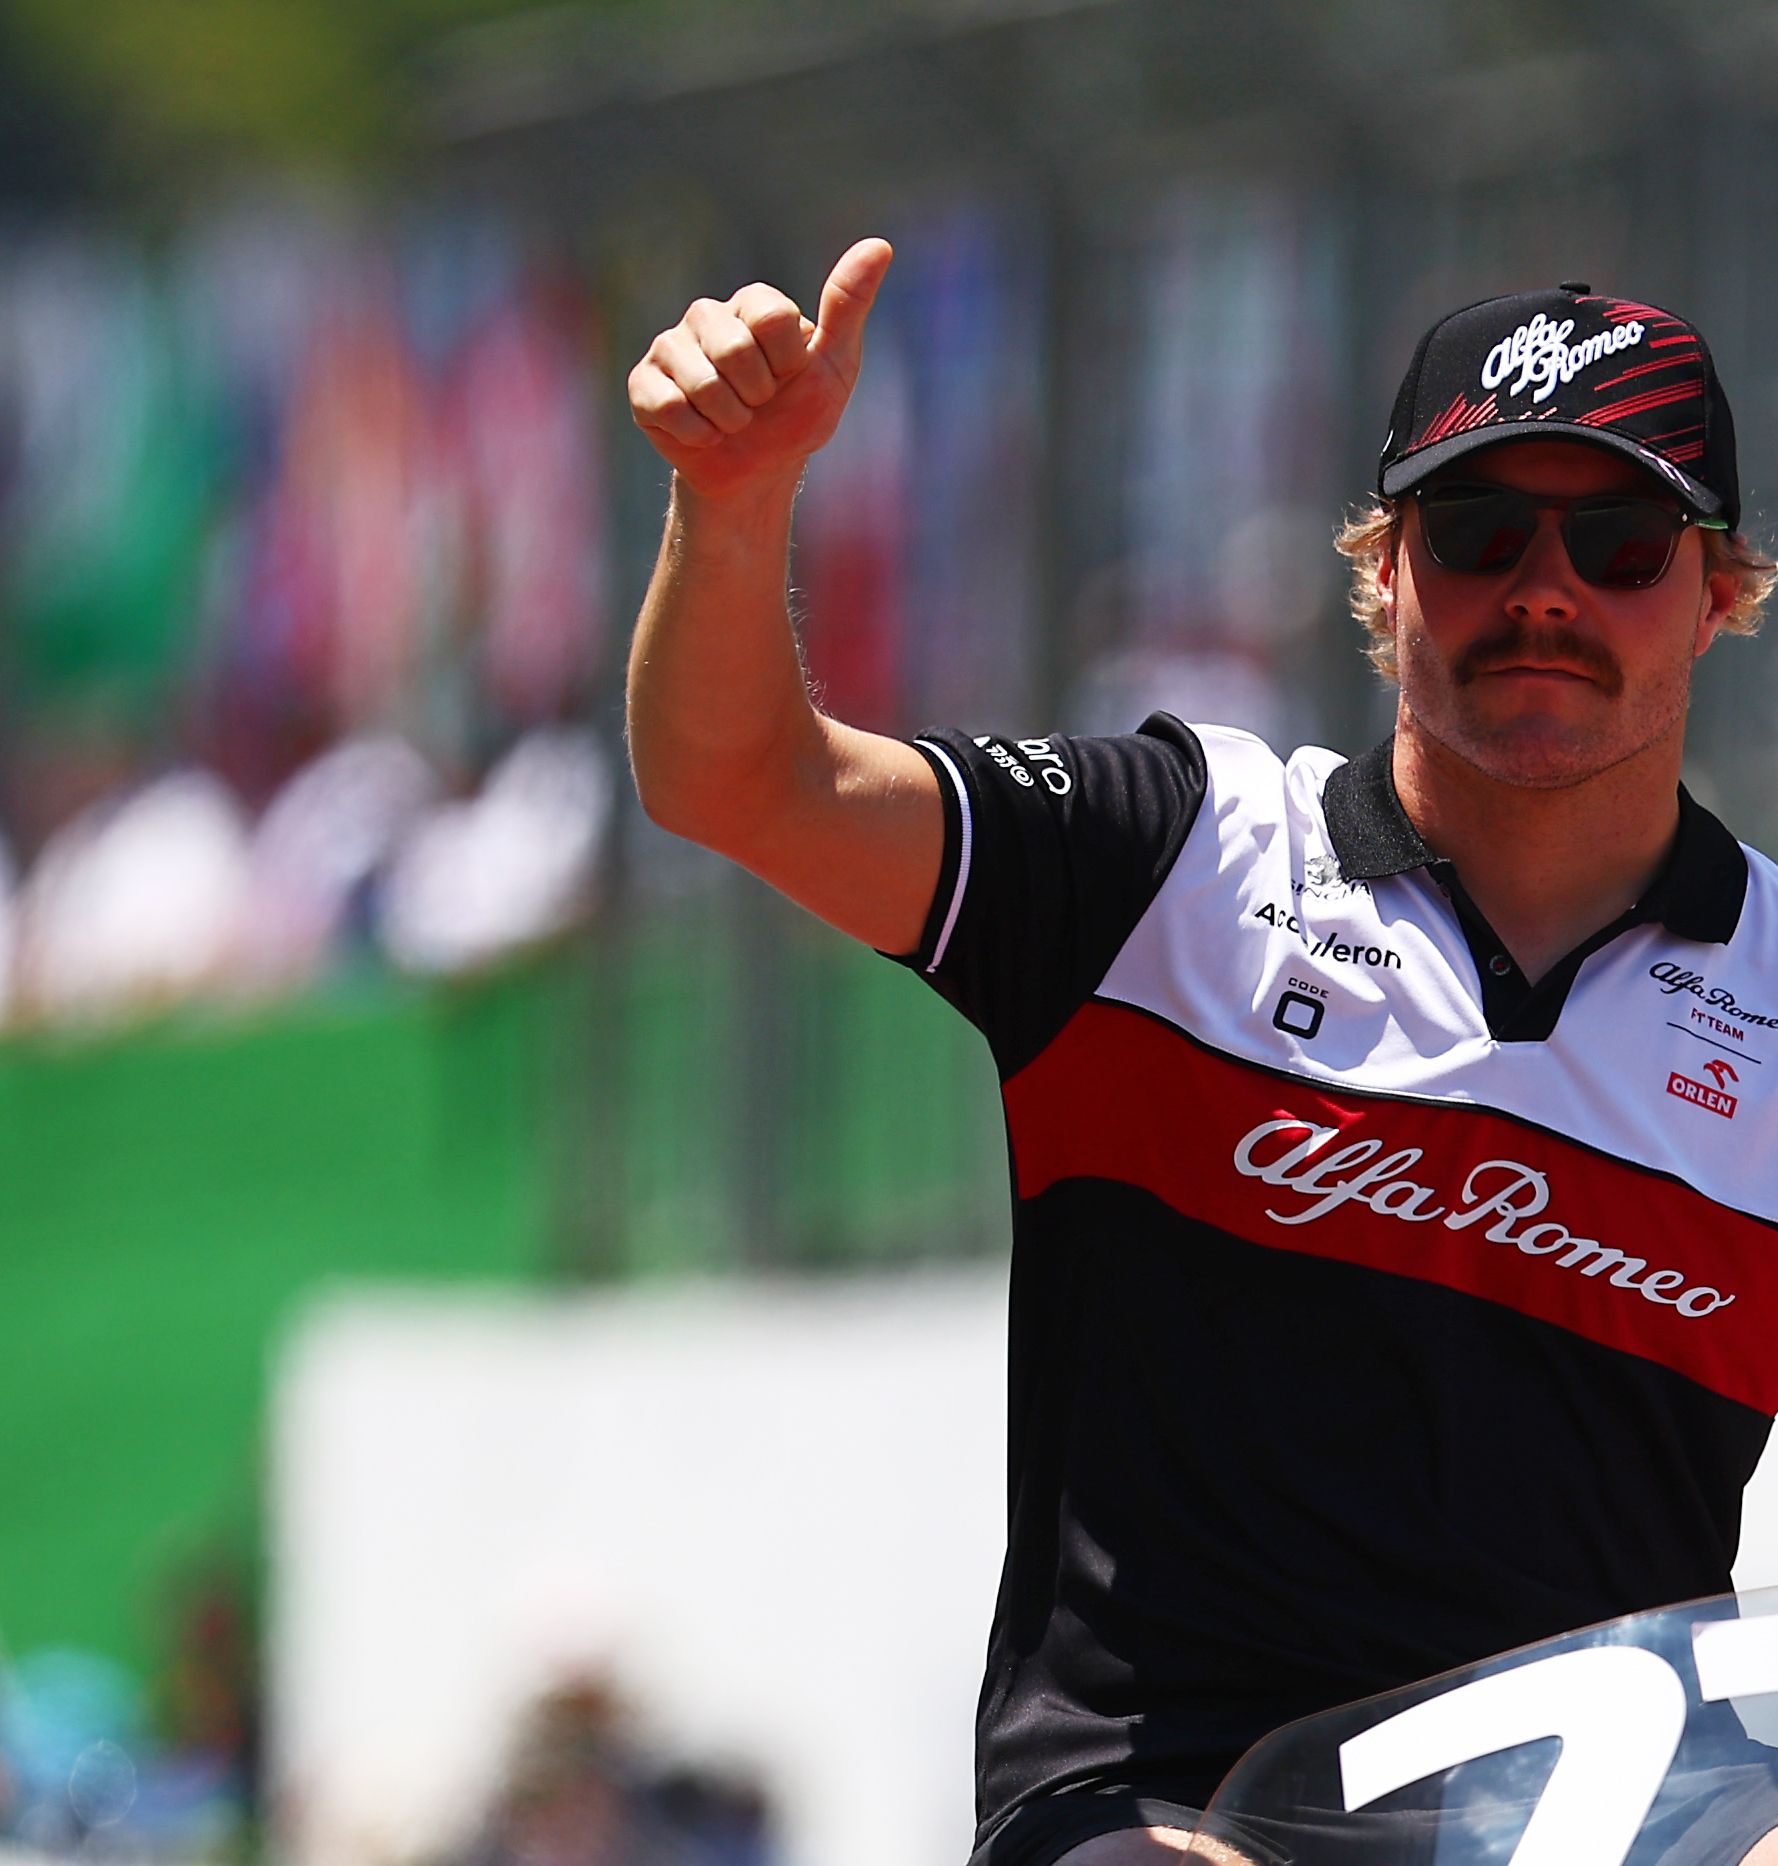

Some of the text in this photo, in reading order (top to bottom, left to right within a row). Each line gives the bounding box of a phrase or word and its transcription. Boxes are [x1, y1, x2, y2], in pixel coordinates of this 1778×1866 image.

[1481, 313, 1575, 398] Alfa
[1530, 320, 1645, 404] Romeo
[1288, 976, 1331, 999] CODE
[1649, 961, 1706, 999] Alfa
[1707, 1015, 1744, 1042] TEAM
[1670, 1076, 1734, 1115] ORLEN
[1232, 1118, 1736, 1317] Alfa Romeo
